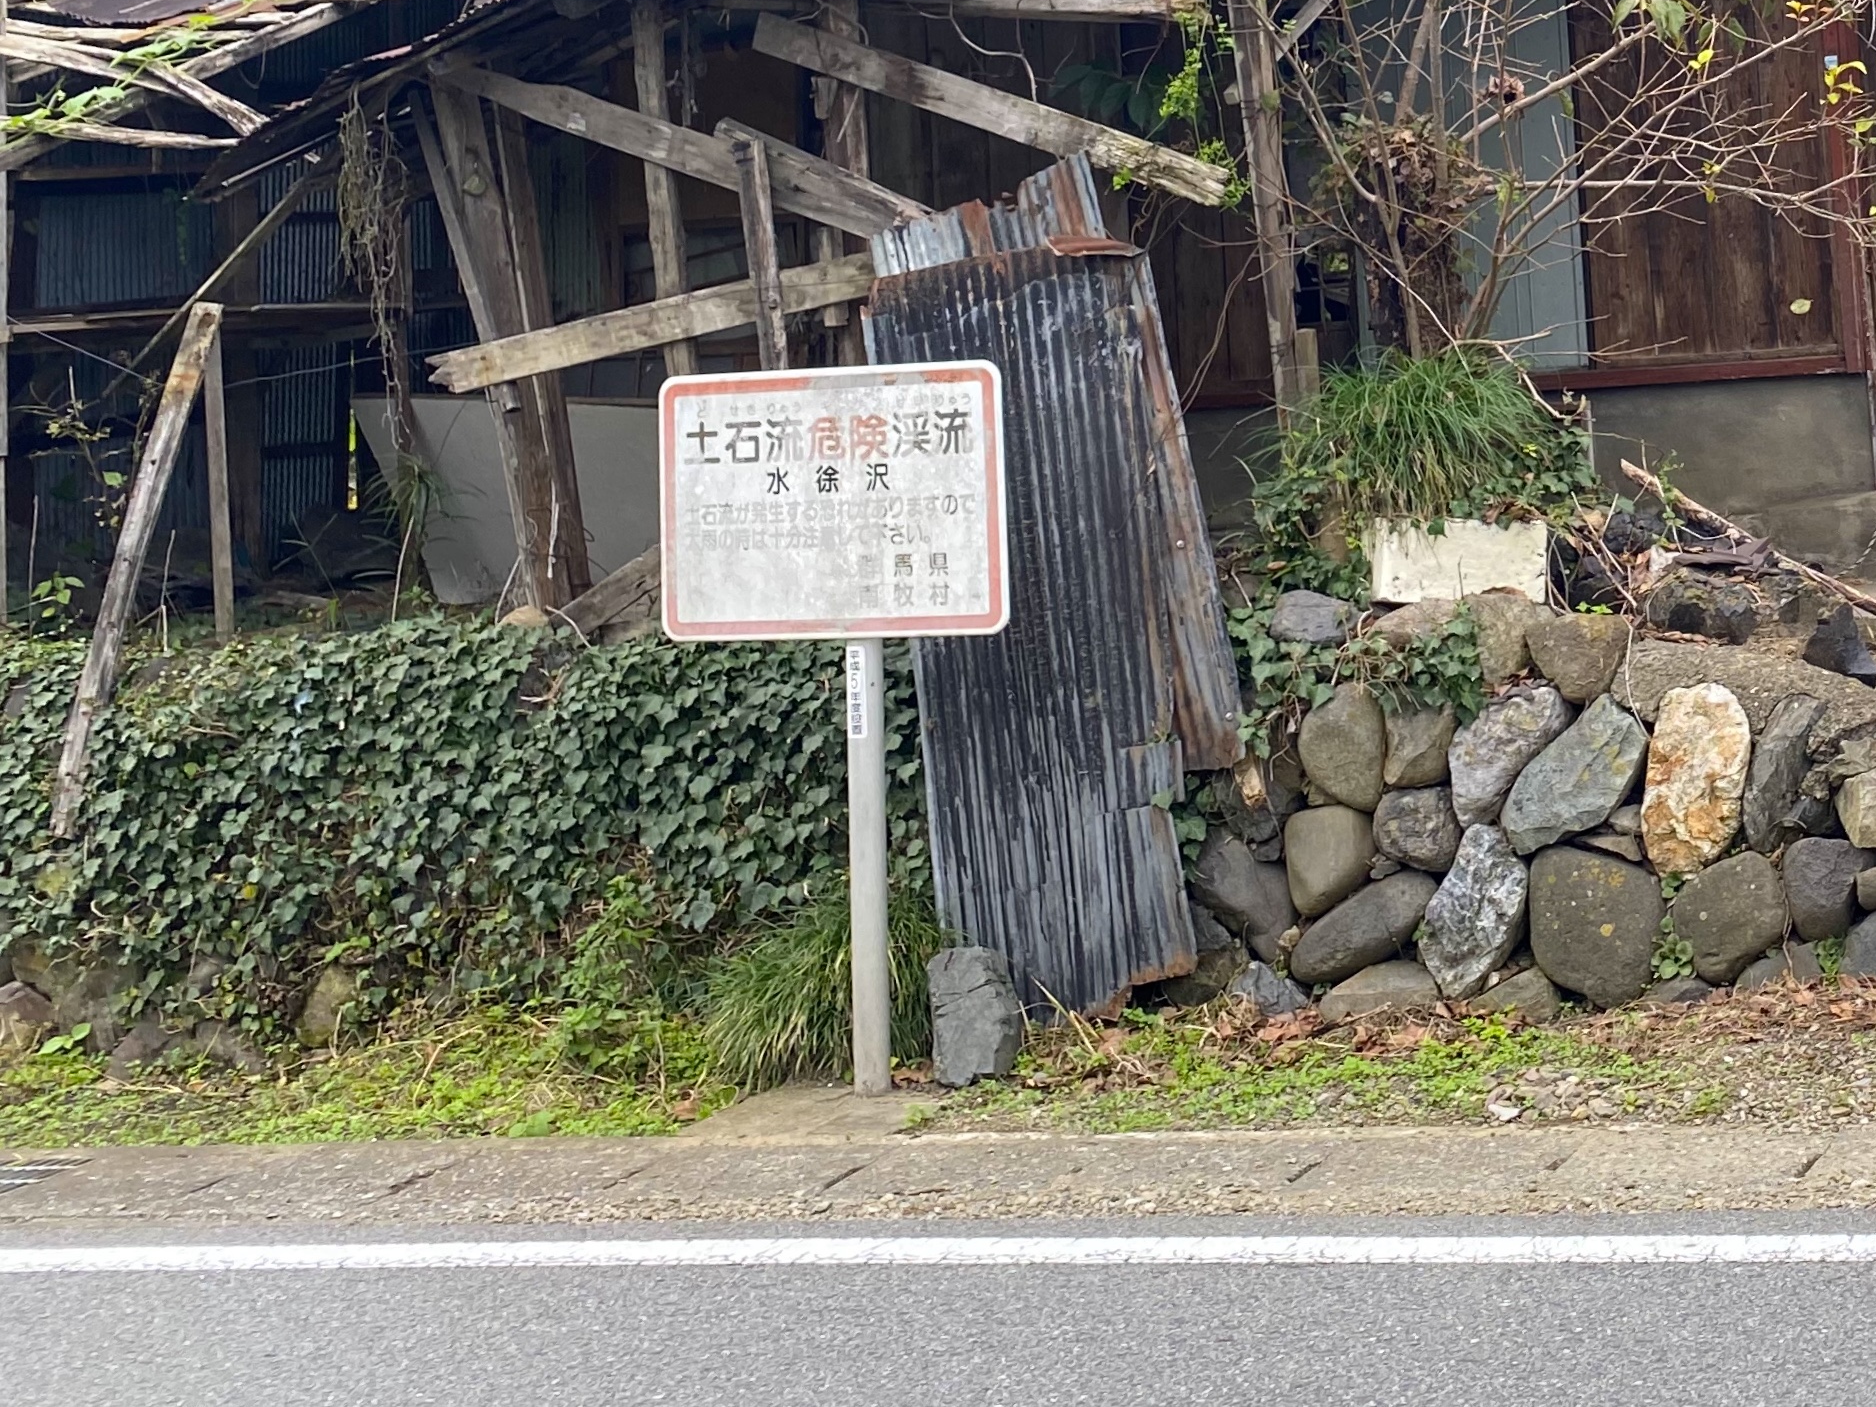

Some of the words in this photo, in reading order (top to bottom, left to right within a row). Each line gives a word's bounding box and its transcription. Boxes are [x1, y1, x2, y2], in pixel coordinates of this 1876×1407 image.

[684, 408, 974, 465] 土石流危険渓流
[685, 522, 932, 551] 大雨の時は十分注して下さい。
